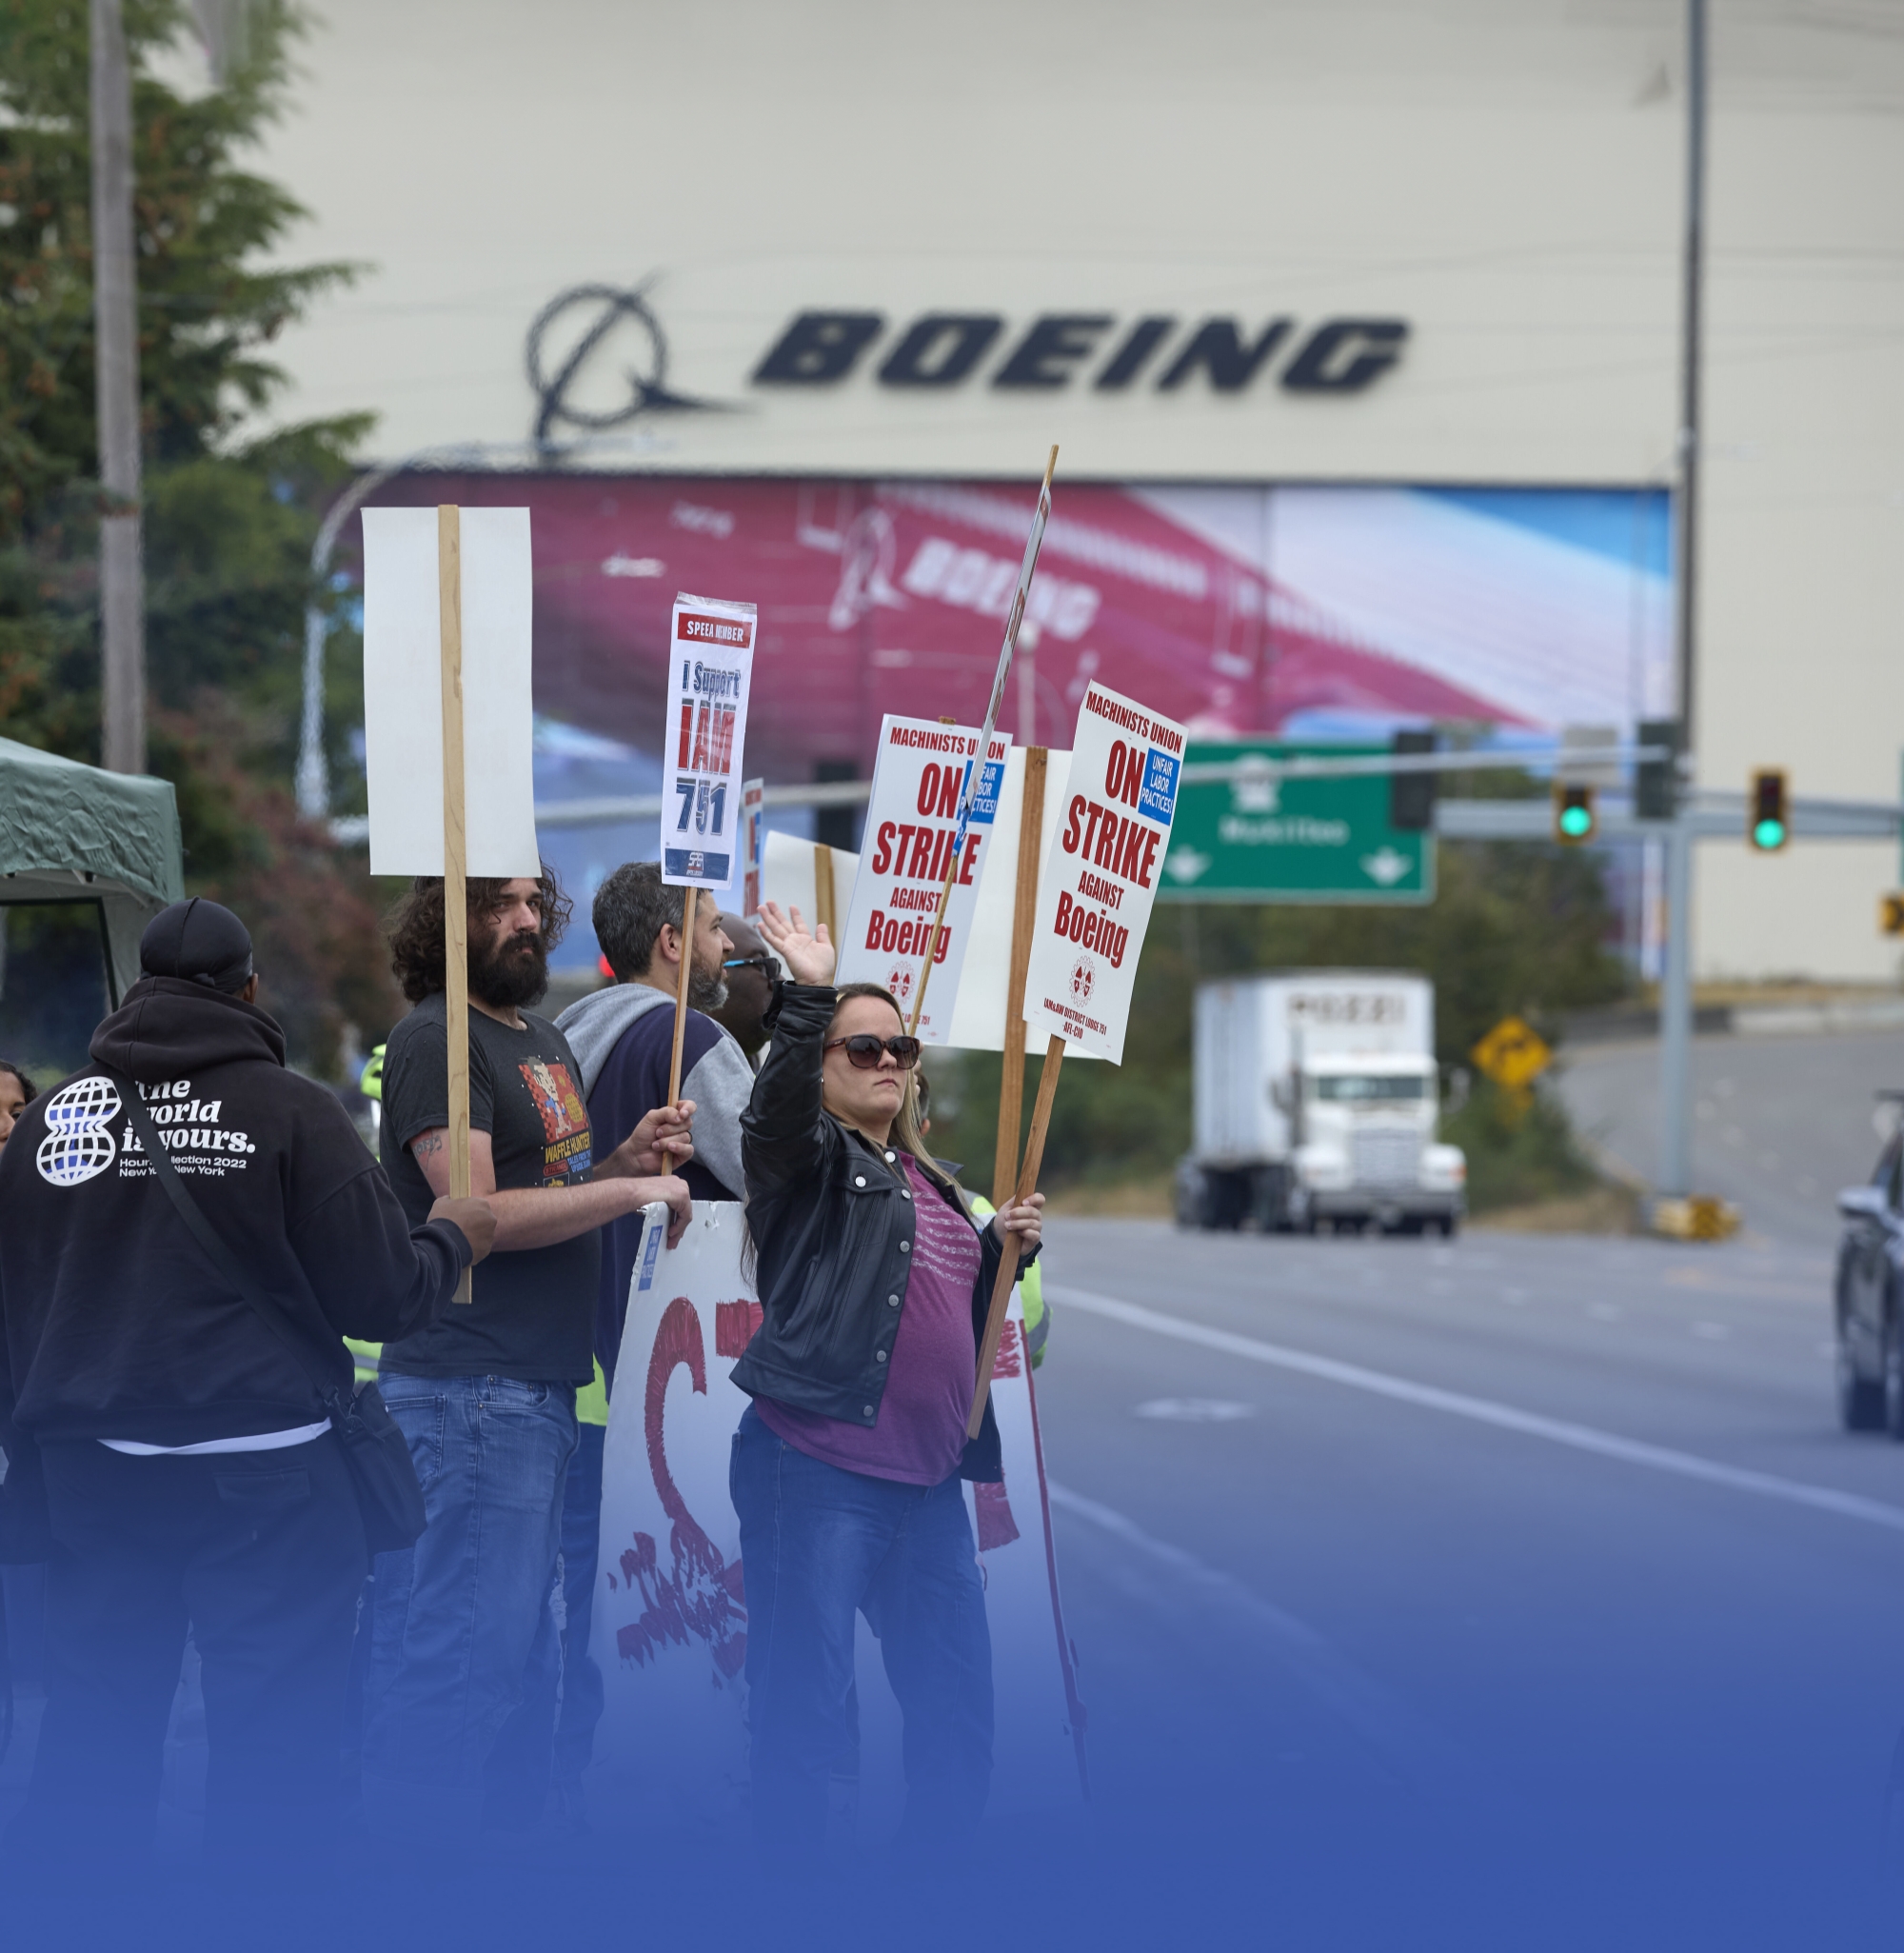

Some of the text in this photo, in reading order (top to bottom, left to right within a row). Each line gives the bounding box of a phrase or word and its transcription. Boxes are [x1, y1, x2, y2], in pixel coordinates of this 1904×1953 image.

[751, 310, 1410, 393] BOEING
[686, 620, 744, 642] SPEEA MEMBER
[682, 661, 741, 702] I Support
[1086, 690, 1182, 754] MACHINISTS UNION
[889, 727, 1005, 760] MACHINISTS UON
[1104, 740, 1146, 808] ON
[1152, 754, 1173, 777] UNFAIR
[917, 763, 963, 819] ON
[1150, 772, 1170, 794] LABOR
[675, 777, 727, 836] 751
[960, 796, 997, 813] PCTICES!
[1140, 787, 1173, 814] PRACTICES!
[872, 821, 982, 886] STRIKE
[1062, 794, 1160, 889] STRIKE
[889, 887, 942, 913] AGAINST
[1078, 870, 1124, 910] AGAINST
[865, 909, 952, 965] Boeing
[1054, 890, 1129, 969] Boeing
[1062, 1021, 1083, 1040] AFL-CIO
[1064, 1006, 1085, 1026] DISTRICT
[1085, 1016, 1100, 1032] LODGE
[1099, 1024, 1107, 1036] 751
[158, 1128, 256, 1154] yours.
[545, 1139, 571, 1164] WAFFLE
[119, 1167, 147, 1178] New
[198, 1166, 225, 1177] York
[213, 1157, 247, 1168] 2022
